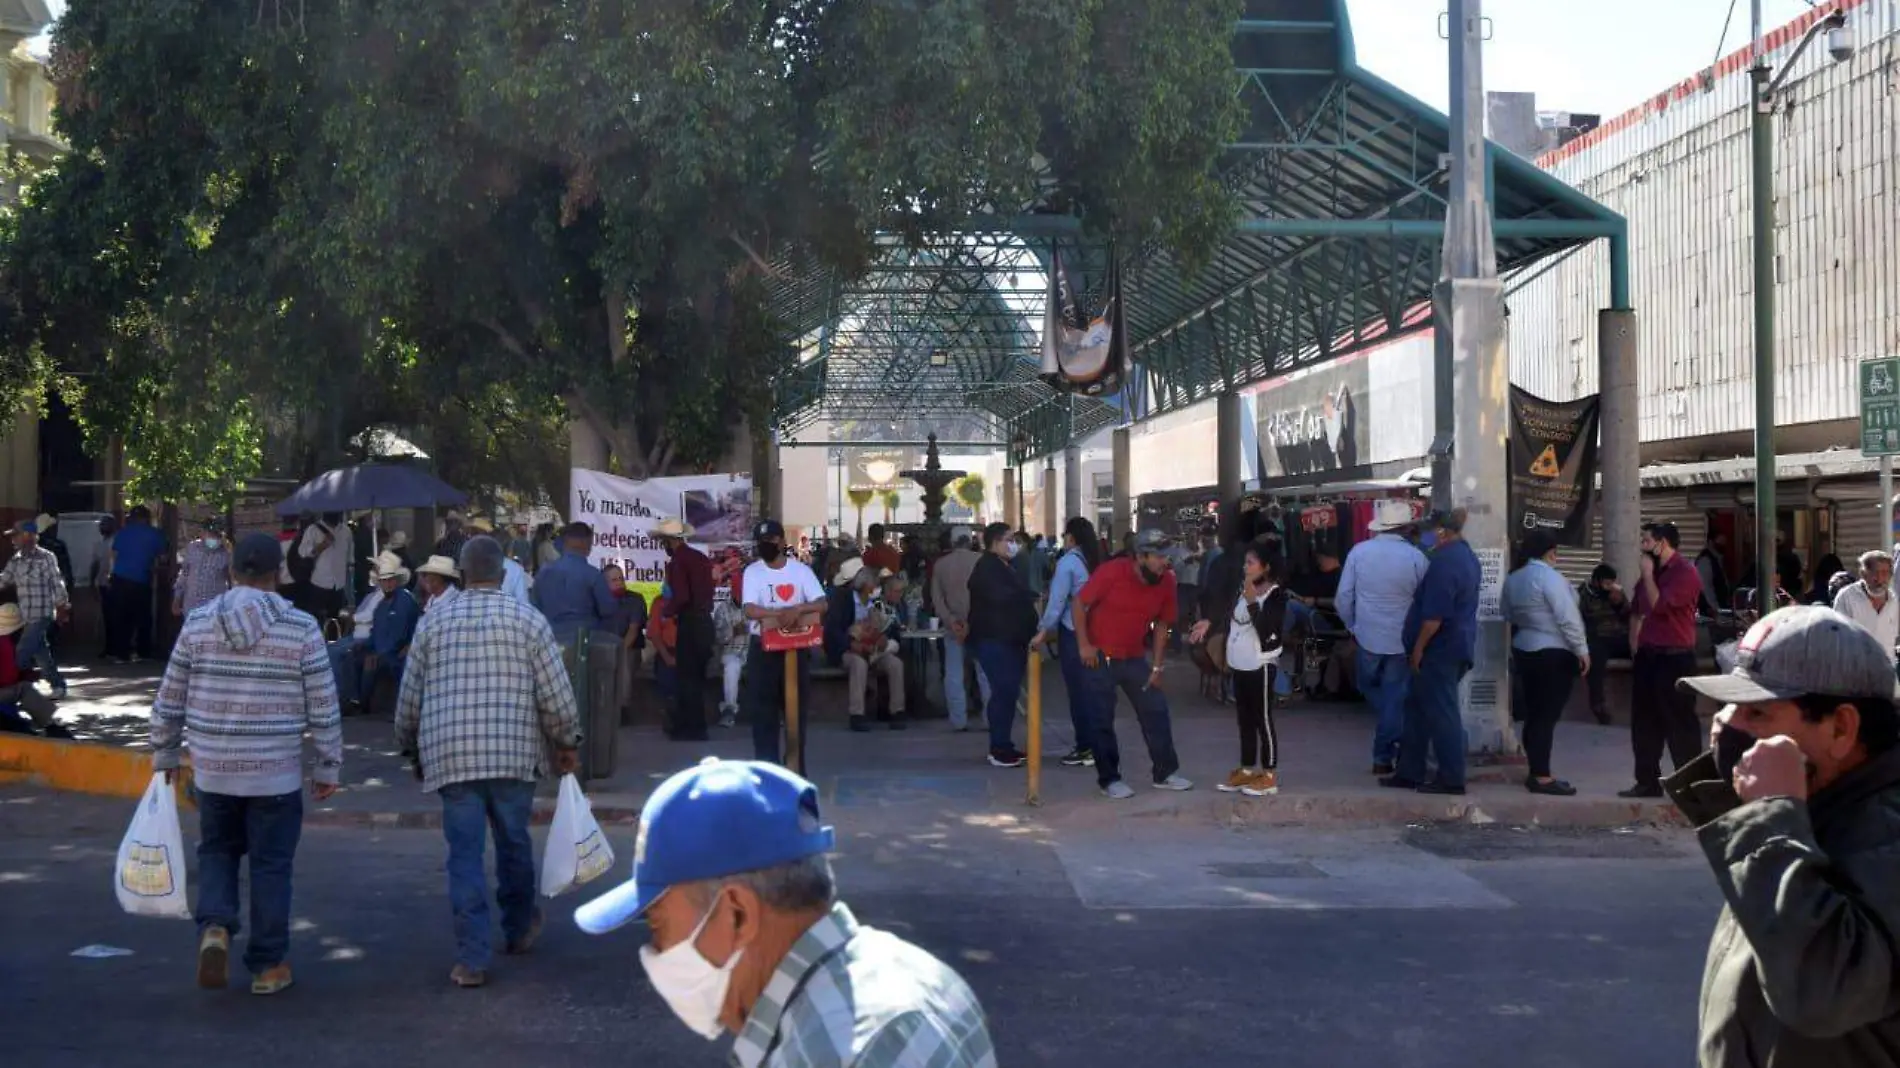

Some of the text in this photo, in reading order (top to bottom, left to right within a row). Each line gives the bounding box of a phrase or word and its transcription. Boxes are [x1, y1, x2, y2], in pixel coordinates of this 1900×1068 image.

[578, 490, 596, 513] Yo
[591, 524, 667, 551] bedecien
[767, 584, 776, 603] I
